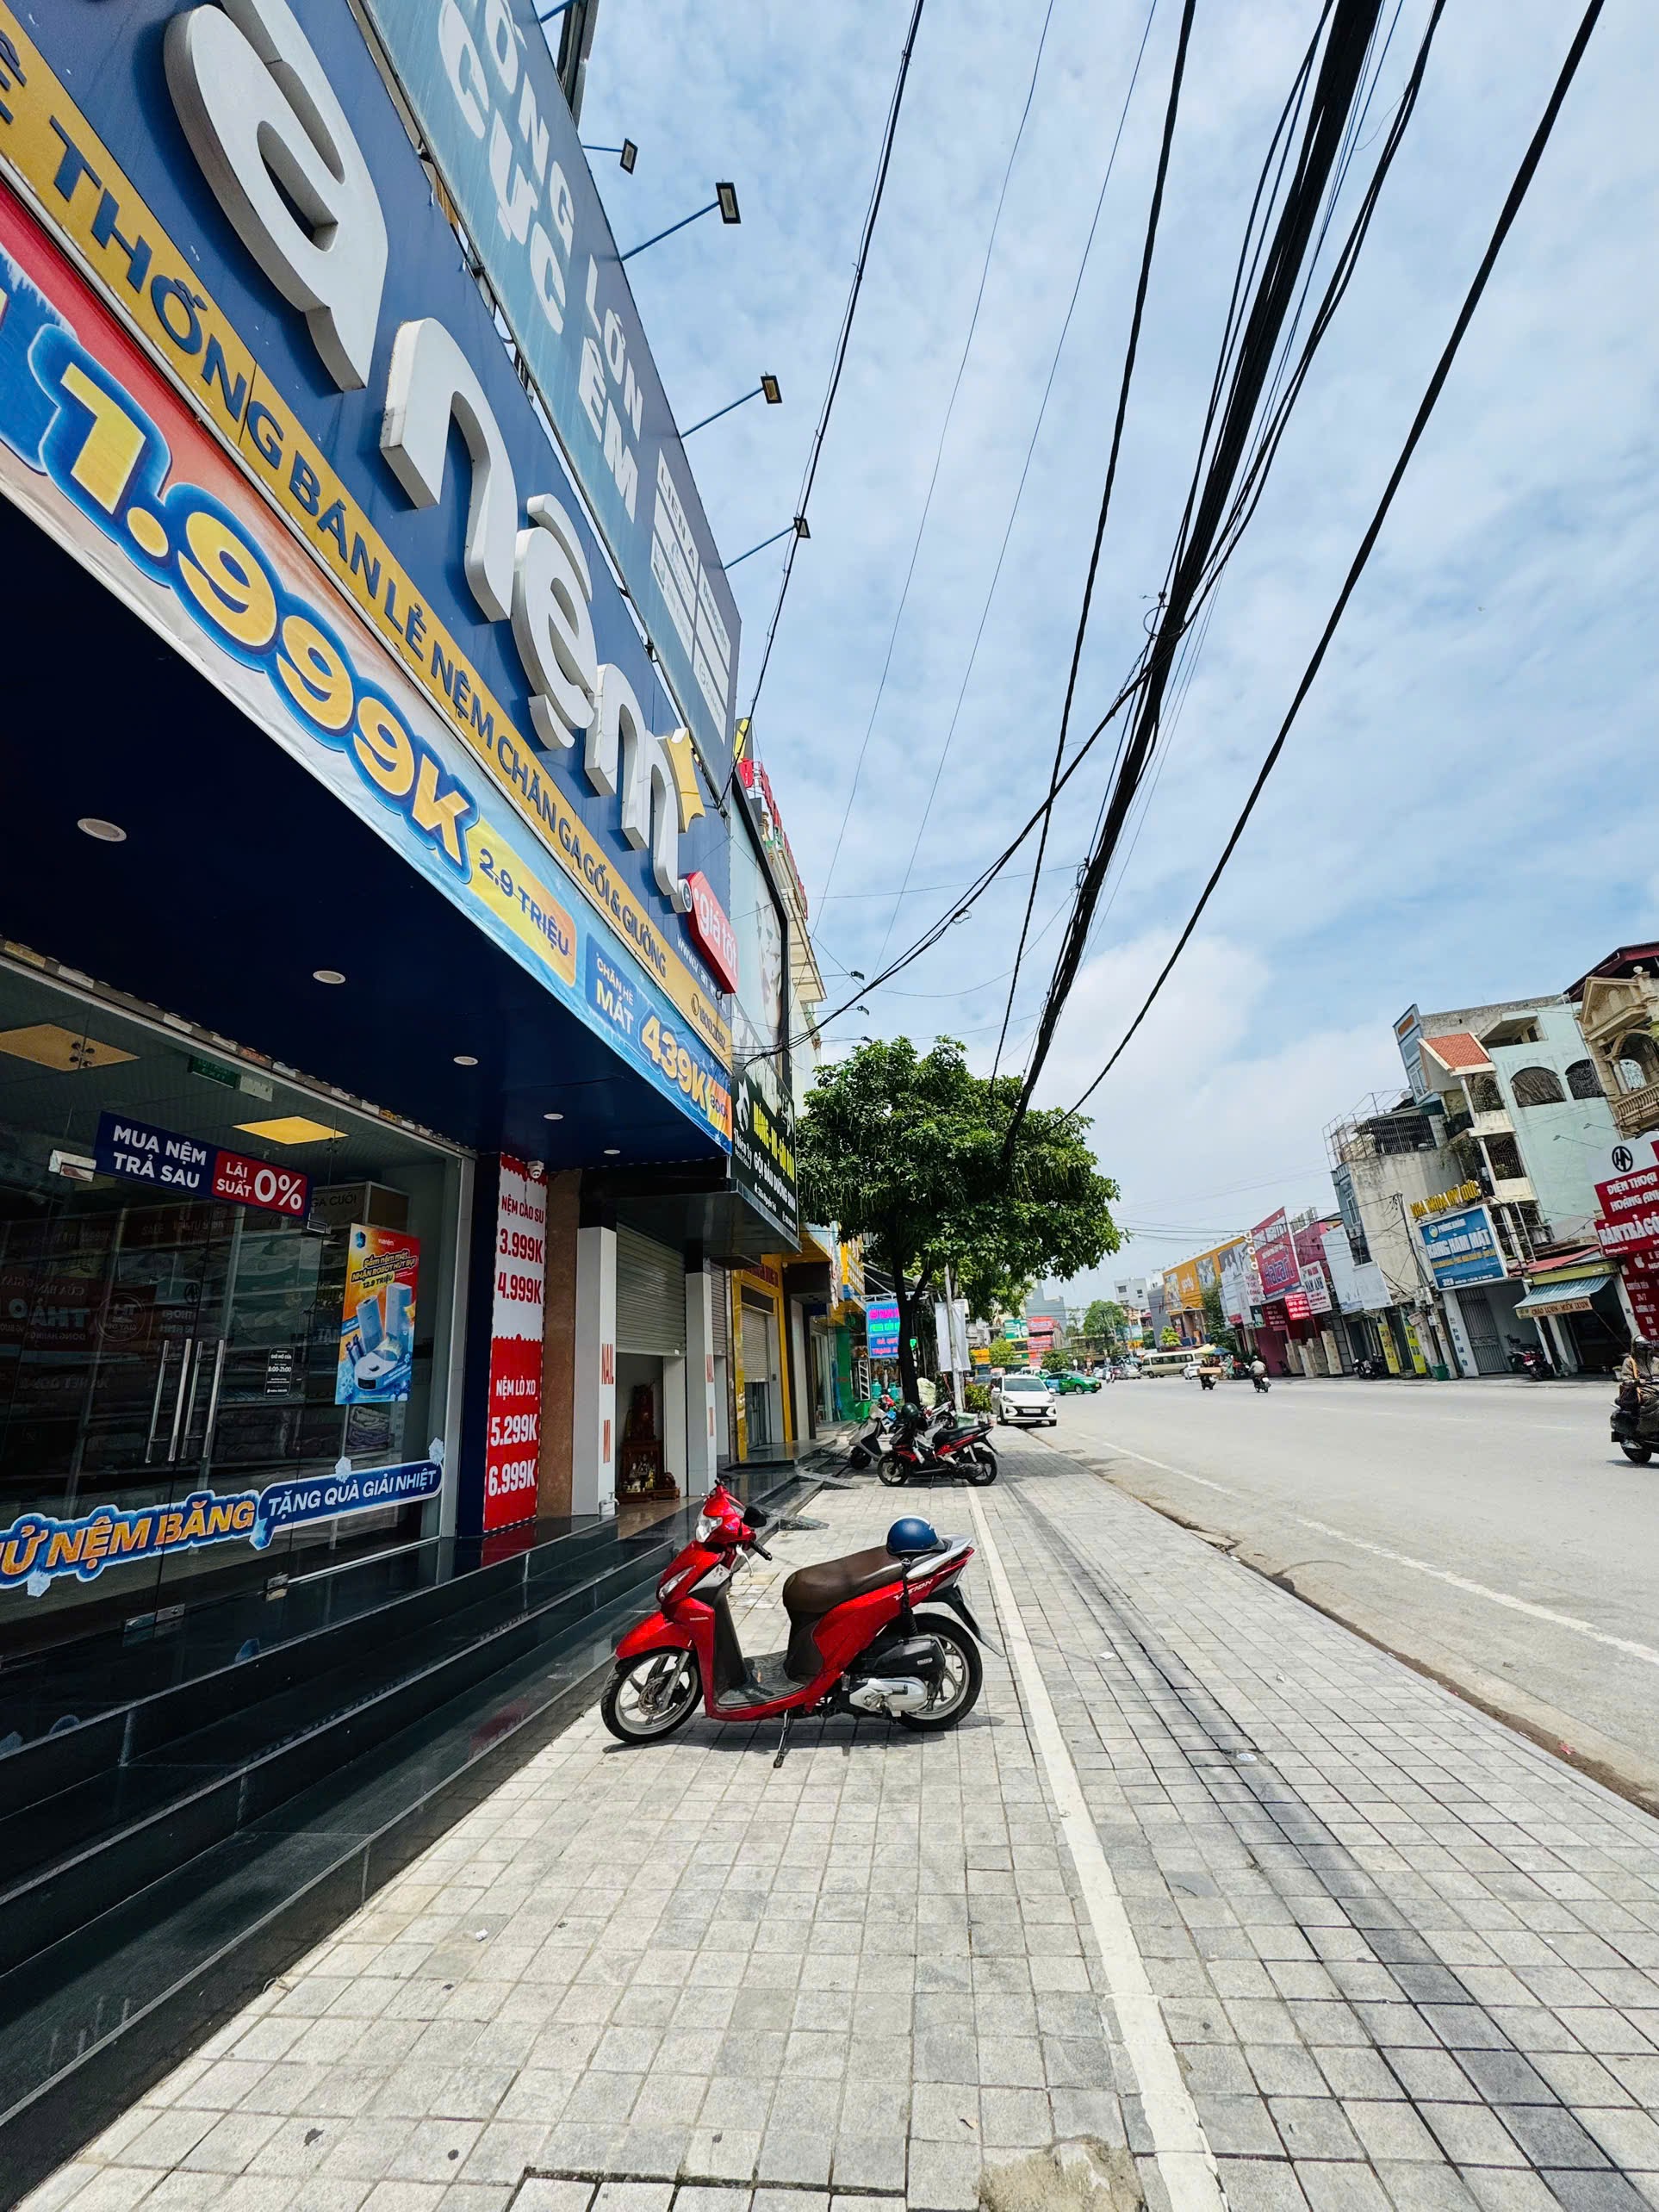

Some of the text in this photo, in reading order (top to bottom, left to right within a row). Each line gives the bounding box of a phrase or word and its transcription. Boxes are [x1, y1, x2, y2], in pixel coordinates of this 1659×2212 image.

[578, 336, 639, 524] ÊM
[49, 115, 667, 979] THỐNG BÁN LẺ NỆM CHĂN GA GỐI & GIƯỜNG
[59, 361, 471, 861] 1.999K
[479, 848, 569, 957] 2.9 TRIỆU
[699, 892, 739, 979] giá tốt
[595, 958, 622, 993] CHĂN
[596, 979, 635, 1035] MÁT
[641, 1014, 707, 1112] 439K
[113, 1125, 207, 1165] MUA NỆM
[113, 1153, 200, 1188] TRẢ SAU
[216, 1177, 252, 1197] SUẤT
[226, 1161, 247, 1178] LÃI
[1607, 1171, 1658, 1196] ĐIỆN THOẠI
[254, 1169, 301, 1210] 0%
[329, 1192, 357, 1206] CƯỚI
[1610, 1193, 1643, 1213] HOÀNG
[501, 1194, 544, 1224] NỆM CAO SU
[500, 1227, 544, 1264] 3.999K
[1426, 1240, 1451, 1259] RĂNG
[1448, 1233, 1472, 1253] HÀM
[1468, 1227, 1492, 1251] MẶT
[497, 1271, 543, 1305] 4.999K
[496, 1375, 514, 1401] NỆM
[515, 1376, 525, 1395] LÒ
[490, 1414, 537, 1446] 5.299K
[268, 1468, 437, 1519] TẶNG QUÀ GIẢI NHIỆT
[488, 1458, 537, 1497] 6.999K
[0, 1501, 256, 1575] Ử NỆM BĂNG
[893, 1578, 933, 1600] VSION
